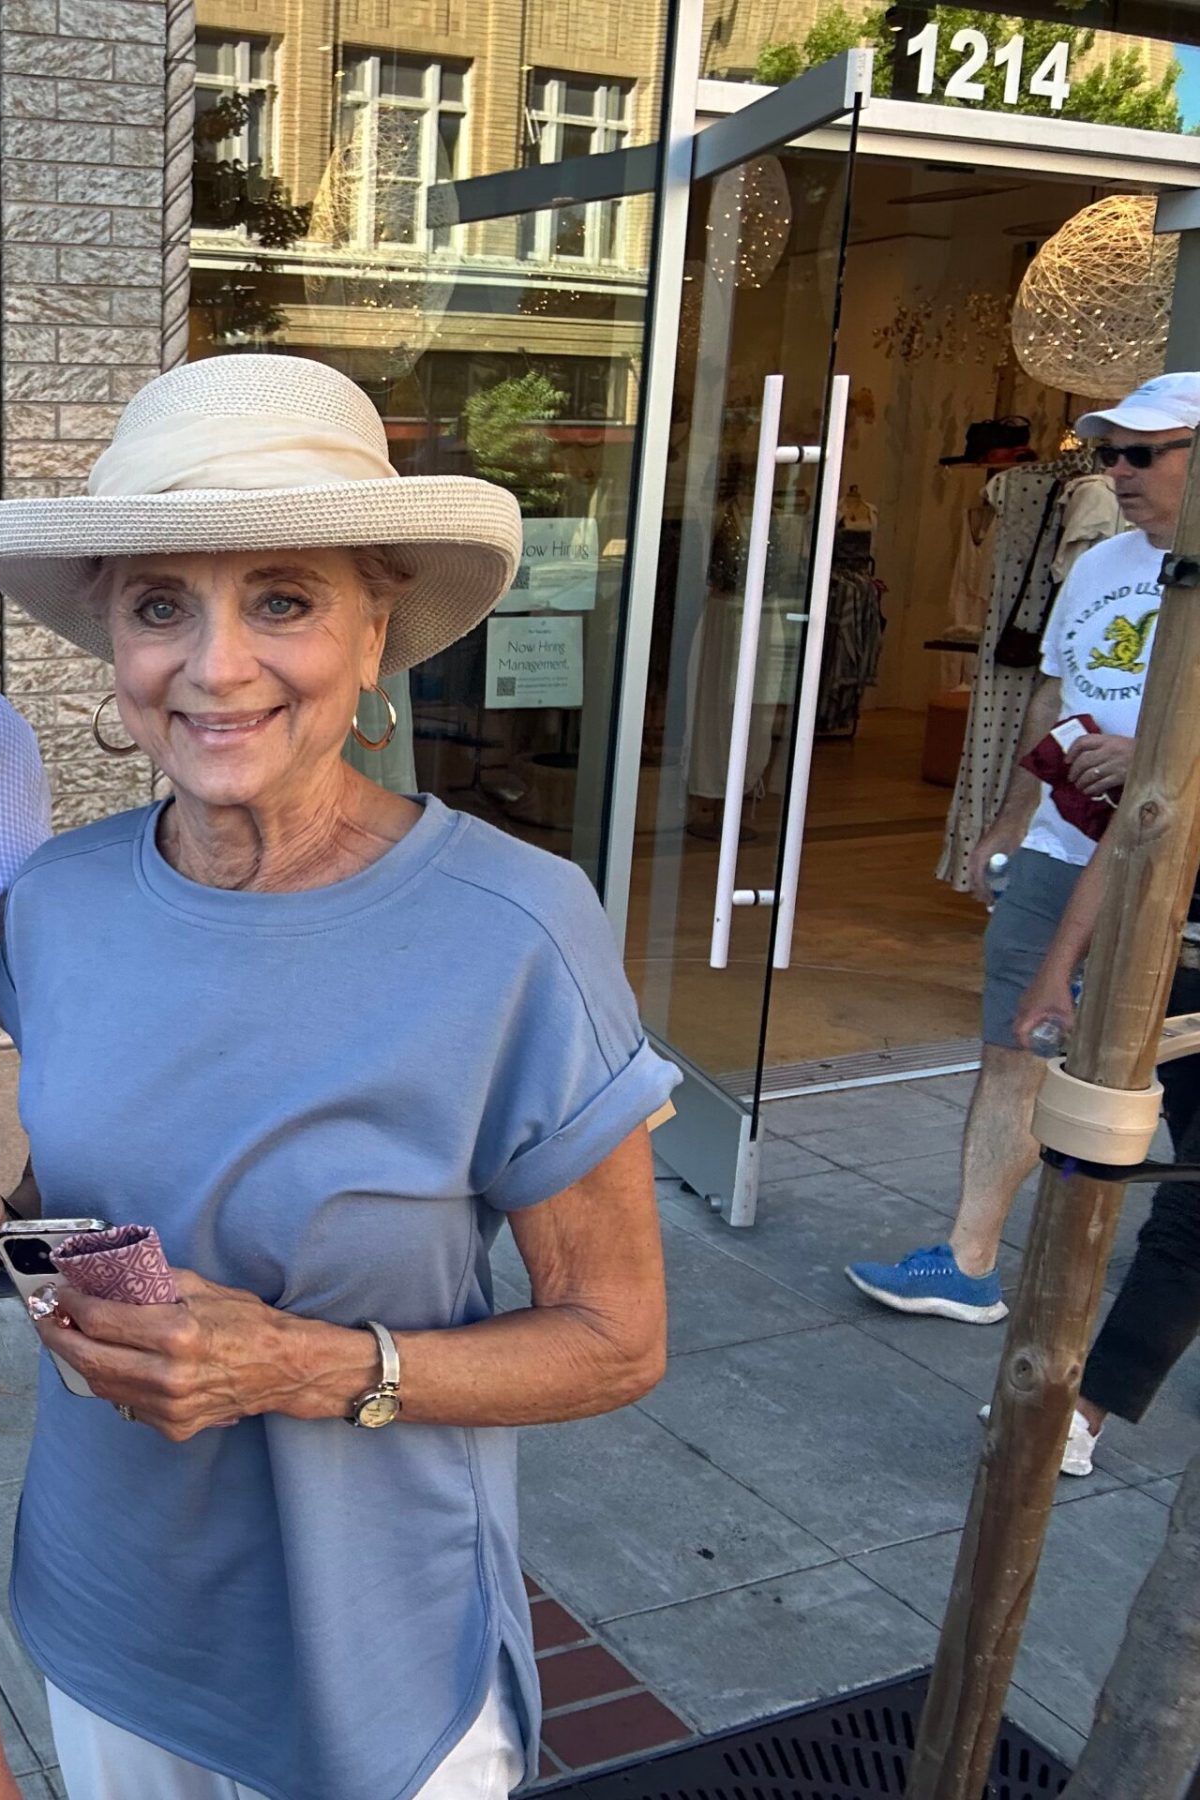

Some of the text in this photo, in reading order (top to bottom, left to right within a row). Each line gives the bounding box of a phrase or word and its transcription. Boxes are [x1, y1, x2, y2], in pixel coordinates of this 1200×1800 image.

[906, 23, 1070, 110] 1214
[507, 639, 567, 655] Now Hiring
[1062, 646, 1081, 676] THE
